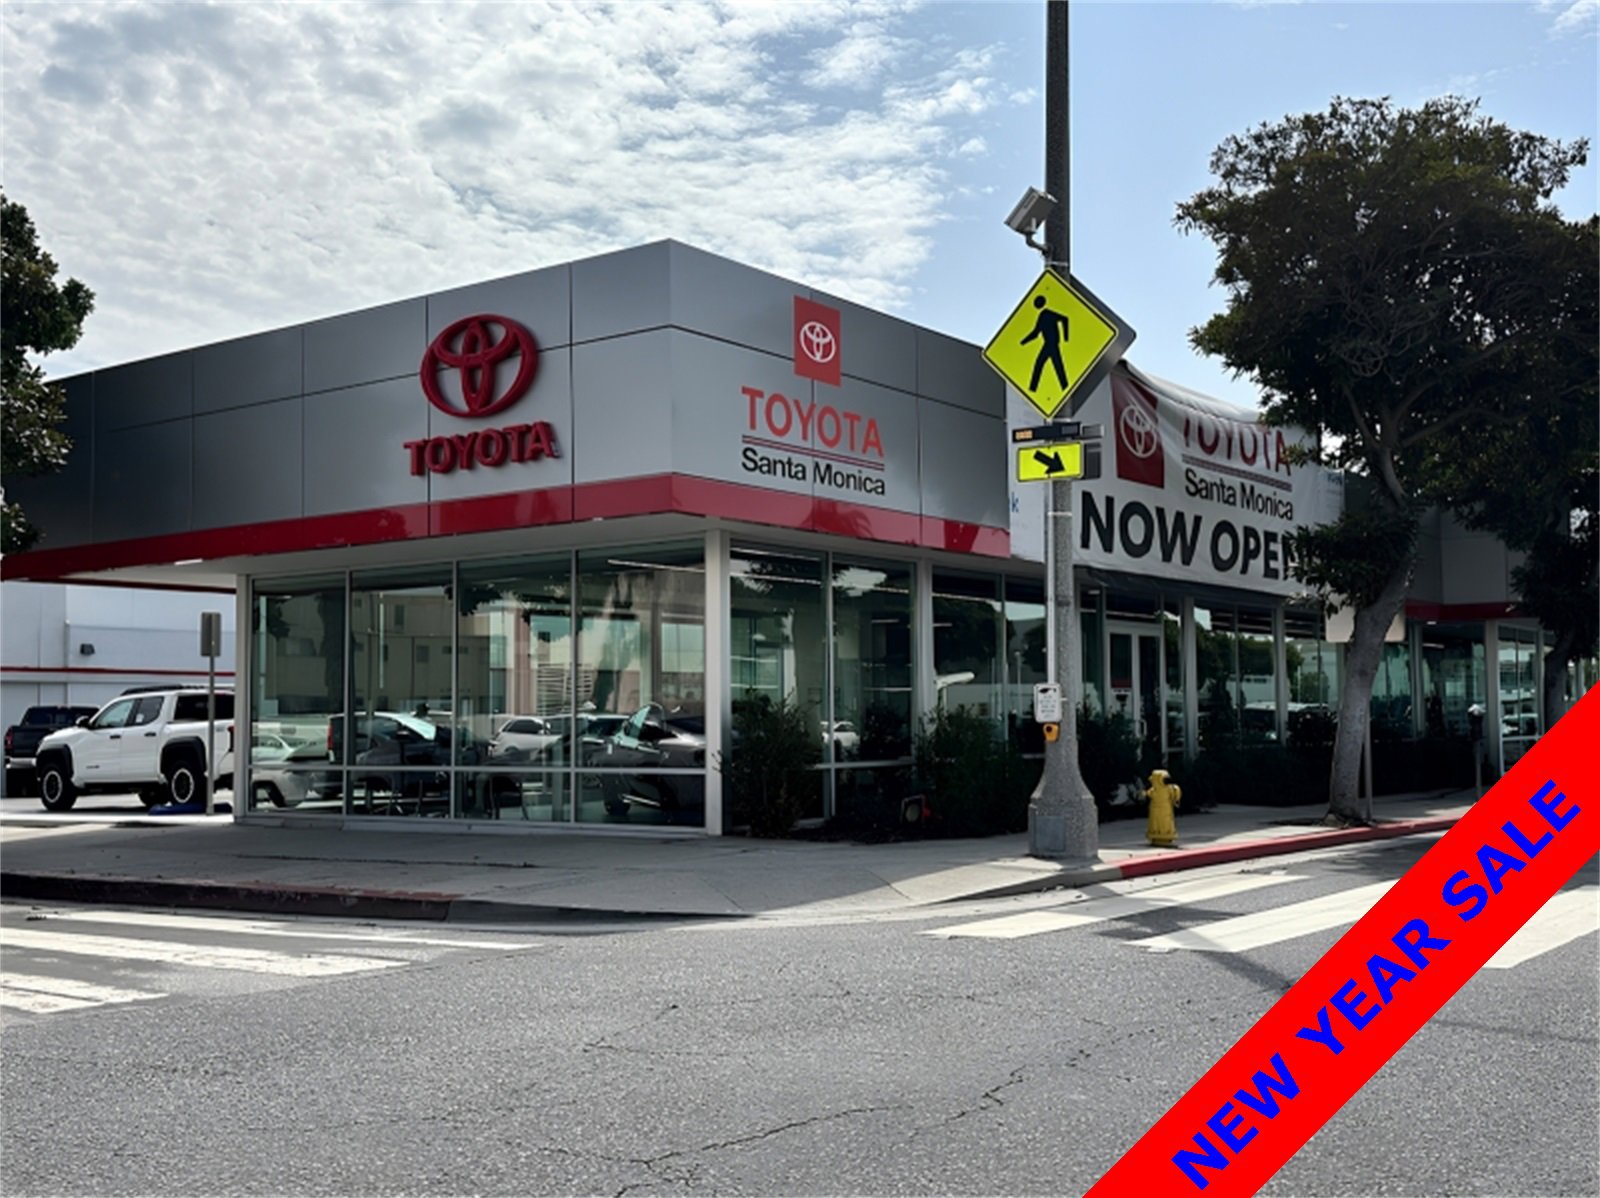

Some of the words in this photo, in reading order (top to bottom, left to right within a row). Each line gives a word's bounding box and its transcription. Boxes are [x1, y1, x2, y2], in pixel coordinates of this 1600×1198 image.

[403, 421, 559, 476] TOYOTA
[741, 385, 884, 458] TOYOTA
[741, 446, 807, 482] Santa
[813, 461, 885, 496] Monica
[1185, 467, 1237, 507] Santa
[1240, 481, 1293, 521] Monica
[1081, 490, 1203, 567] NOW
